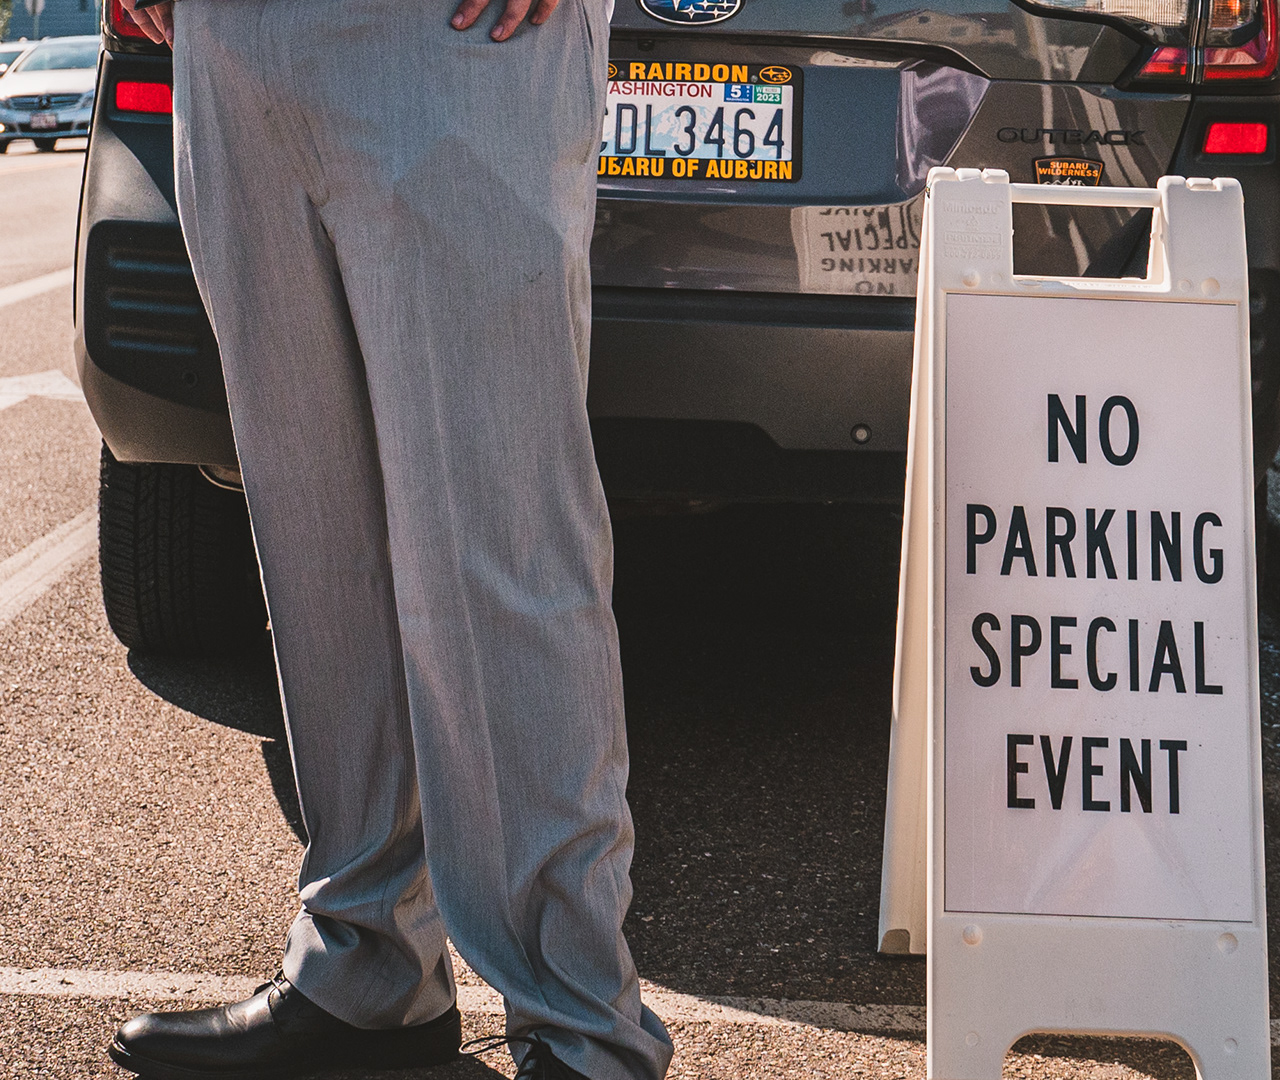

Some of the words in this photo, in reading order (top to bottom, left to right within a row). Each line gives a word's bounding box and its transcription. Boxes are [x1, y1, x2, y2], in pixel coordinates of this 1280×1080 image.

[629, 62, 748, 83] RAIRDON
[607, 81, 712, 98] ASHINGTON
[730, 85, 742, 98] 5
[756, 93, 780, 102] 2023
[996, 126, 1145, 146] OUTBACK
[597, 156, 664, 177] UBARU
[672, 158, 699, 178] OF
[705, 160, 793, 180] AUBURN
[1038, 168, 1099, 177] WILDERNESS
[1049, 161, 1089, 170] SUBARU
[821, 258, 919, 274] ARKING
[1047, 393, 1140, 466] NO
[966, 503, 1224, 584] PARKING
[970, 612, 1224, 695] SPECIAL
[1006, 733, 1188, 814] EVENT
